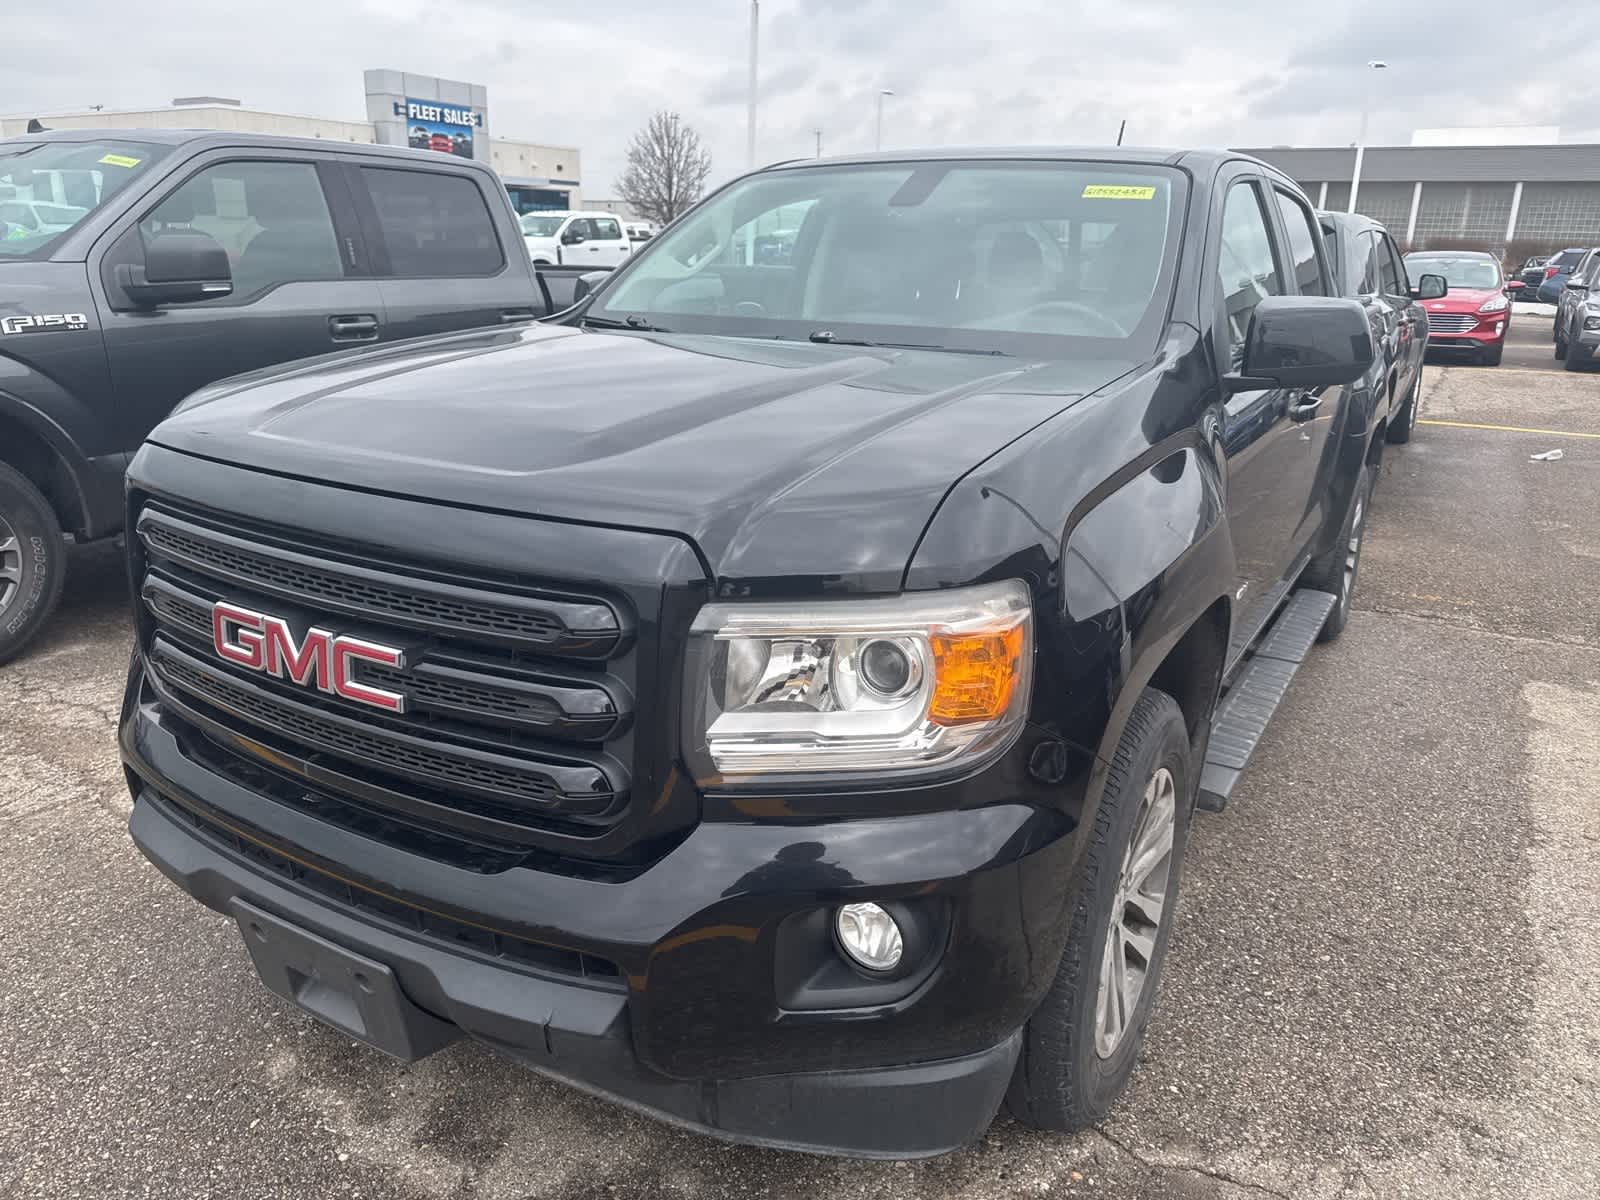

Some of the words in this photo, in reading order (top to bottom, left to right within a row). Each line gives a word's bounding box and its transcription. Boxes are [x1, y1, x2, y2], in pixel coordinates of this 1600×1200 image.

[408, 103, 441, 122] FLEET
[443, 109, 475, 126] SALES
[212, 601, 404, 713] GMC
